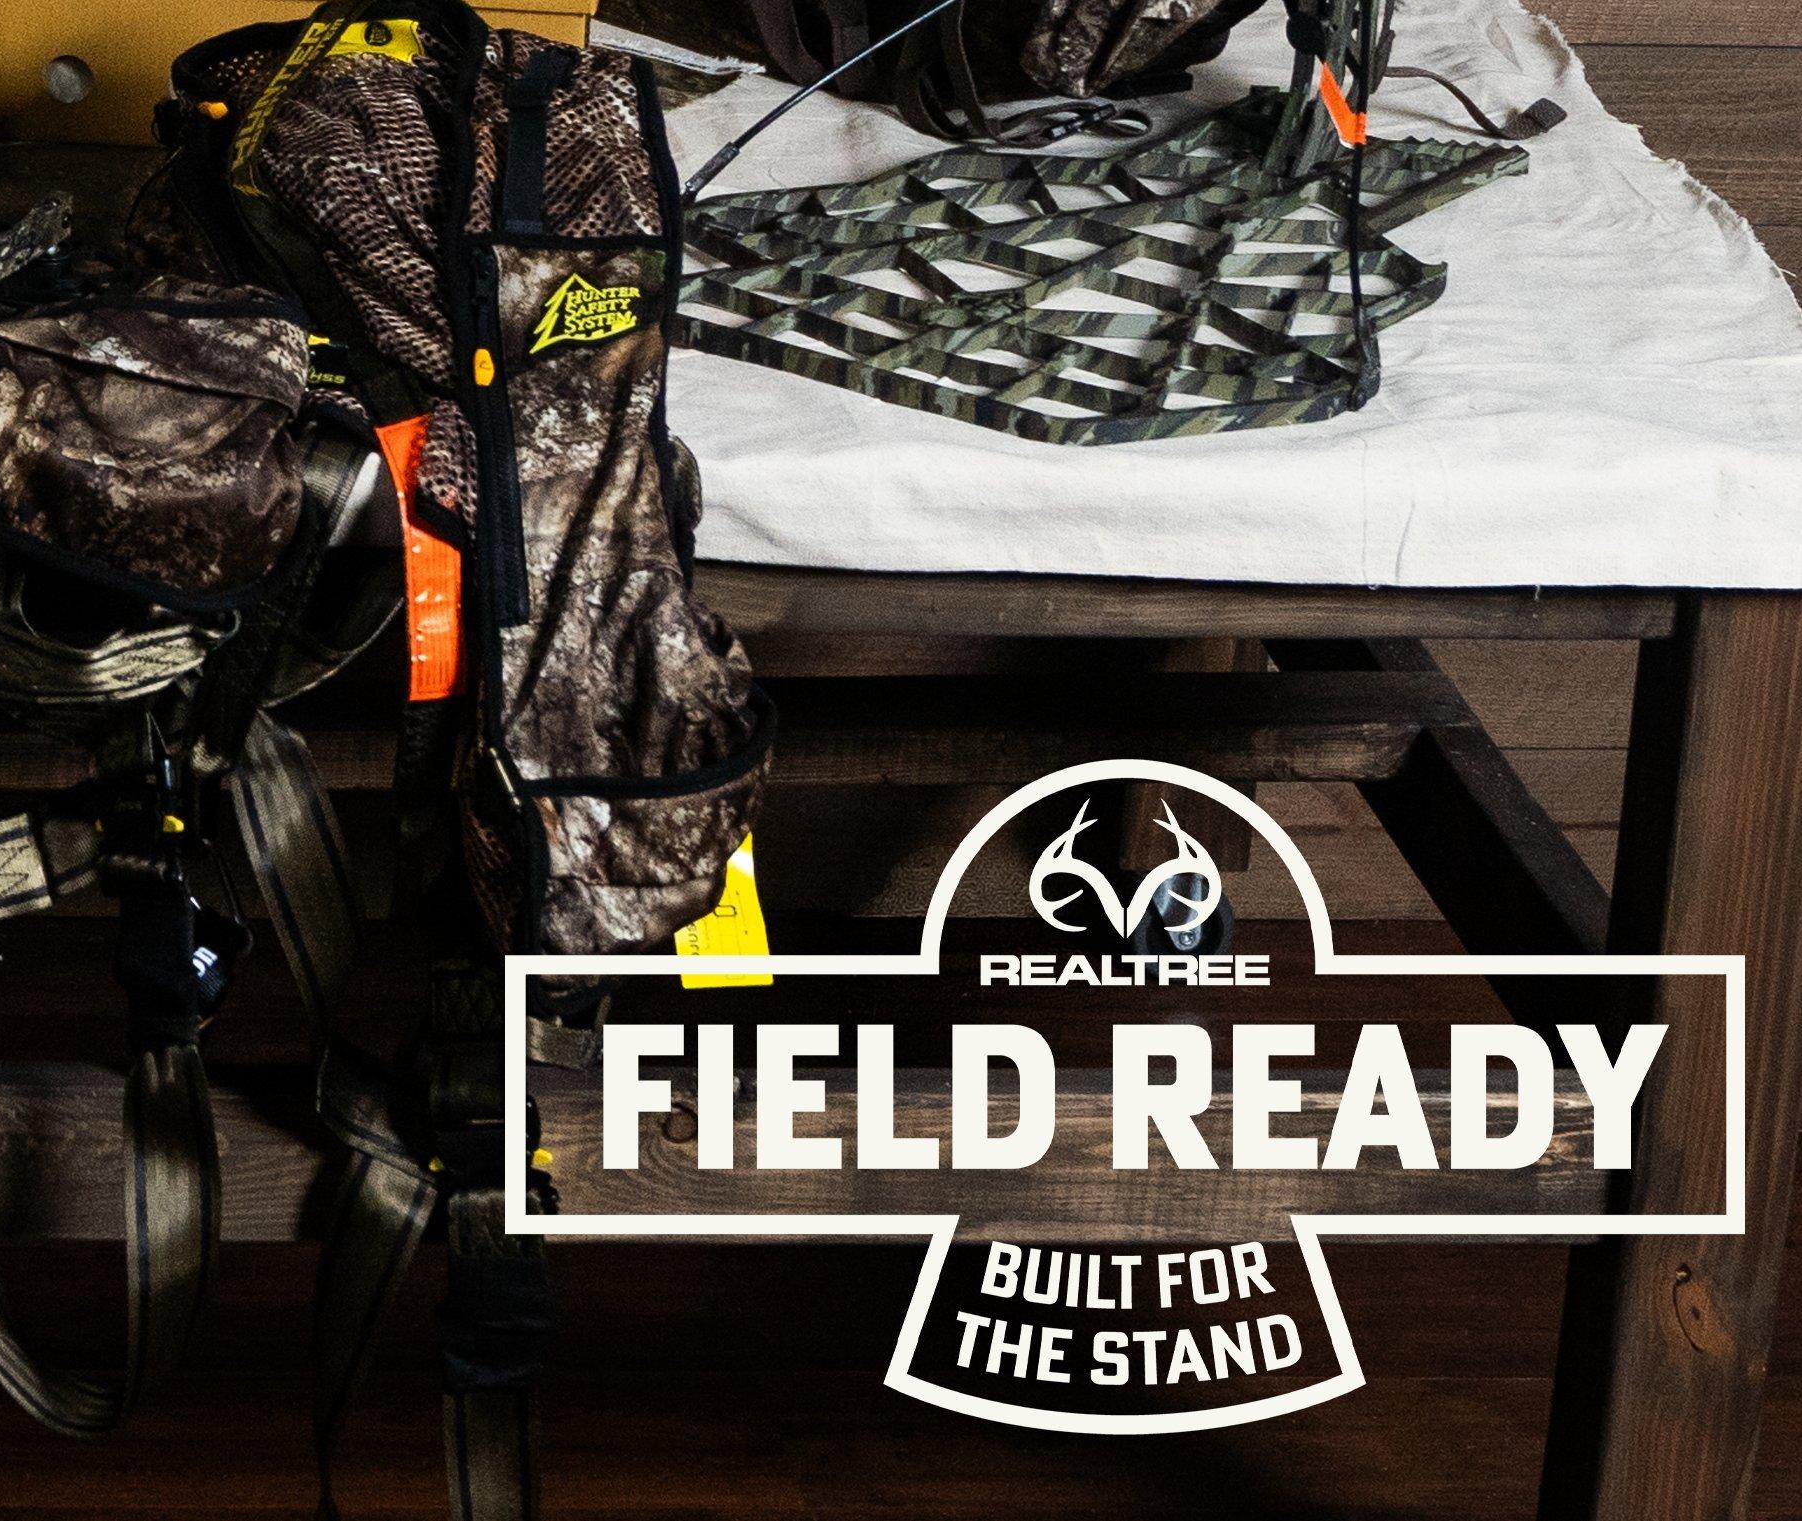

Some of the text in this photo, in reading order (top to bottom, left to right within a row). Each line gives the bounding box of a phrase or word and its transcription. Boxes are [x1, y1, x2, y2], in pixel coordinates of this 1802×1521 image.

[566, 286, 642, 304] HUNTER
[564, 298, 632, 319] SAFETY
[564, 311, 636, 335] SYSTEM
